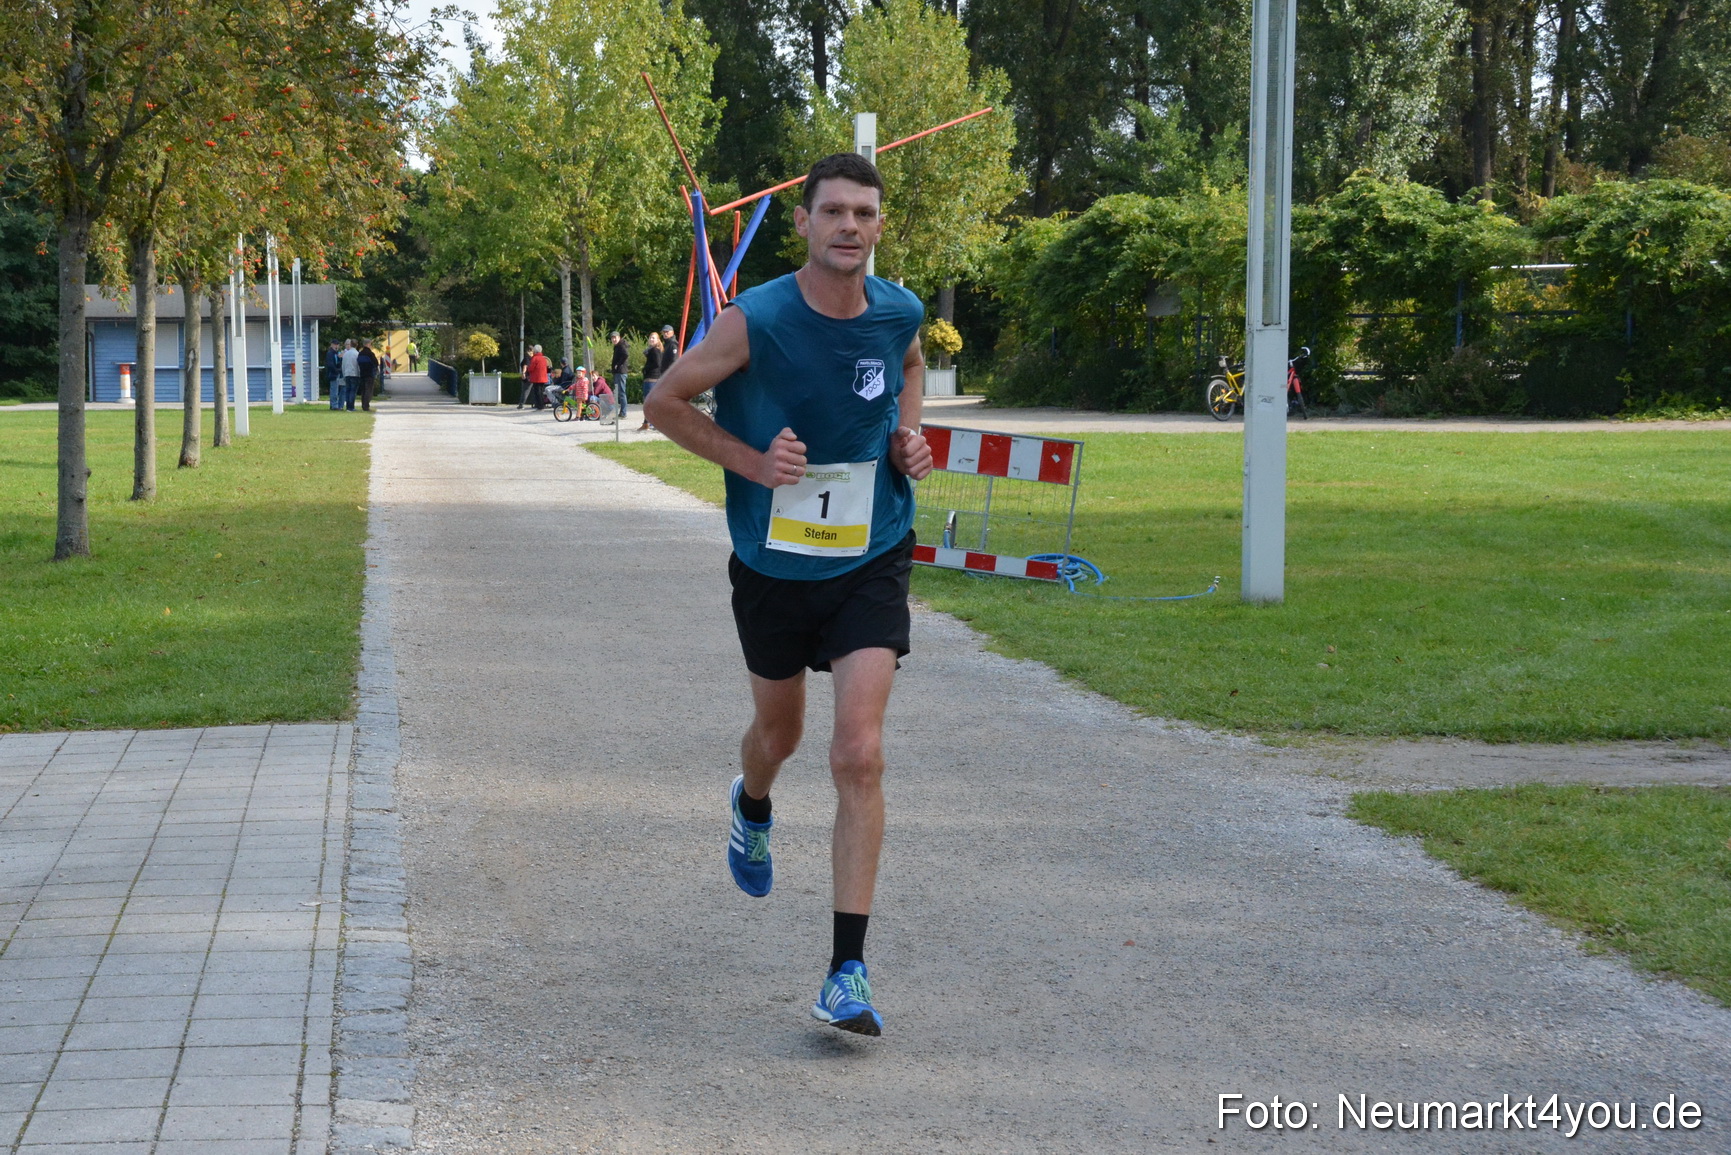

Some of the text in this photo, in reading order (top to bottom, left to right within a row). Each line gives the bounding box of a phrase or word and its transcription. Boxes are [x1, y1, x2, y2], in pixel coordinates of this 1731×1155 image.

[862, 366, 877, 387] TSV
[865, 378, 881, 397] 1965
[818, 491, 830, 519] 1
[804, 527, 837, 541] Stefan
